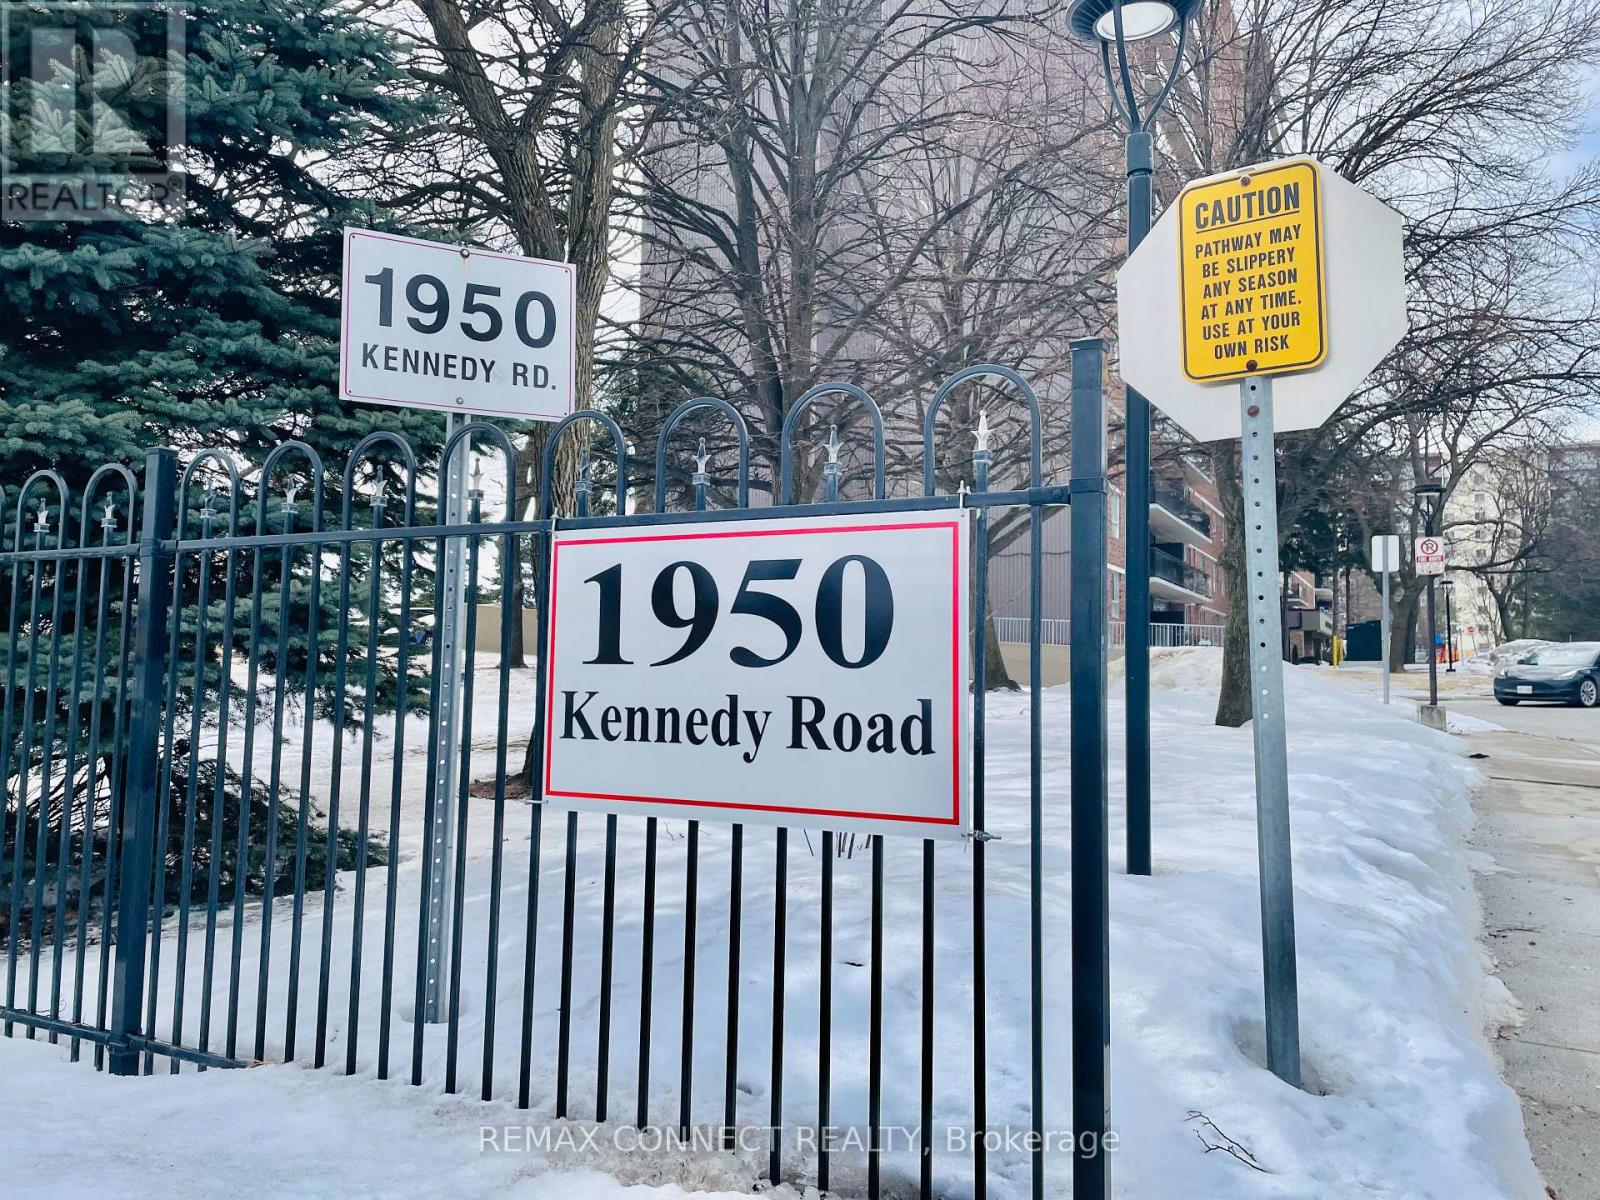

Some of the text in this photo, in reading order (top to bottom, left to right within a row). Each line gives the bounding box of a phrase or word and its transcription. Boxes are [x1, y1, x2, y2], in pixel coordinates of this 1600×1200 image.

[1195, 182, 1299, 229] CAUTION
[1196, 224, 1301, 259] PATHWAY MAY
[1203, 247, 1295, 278] BE SLIPPERY
[1203, 268, 1297, 299] ANY SEASON
[365, 267, 557, 349] 1950
[1201, 290, 1301, 320] AT ANY TIME.
[1203, 311, 1300, 340] USE AT YOUR
[1214, 334, 1289, 360] OWN RISK
[362, 342, 556, 390] KENNEDY RD.
[582, 554, 894, 669] 1950
[559, 690, 936, 763] Kennedy Road
